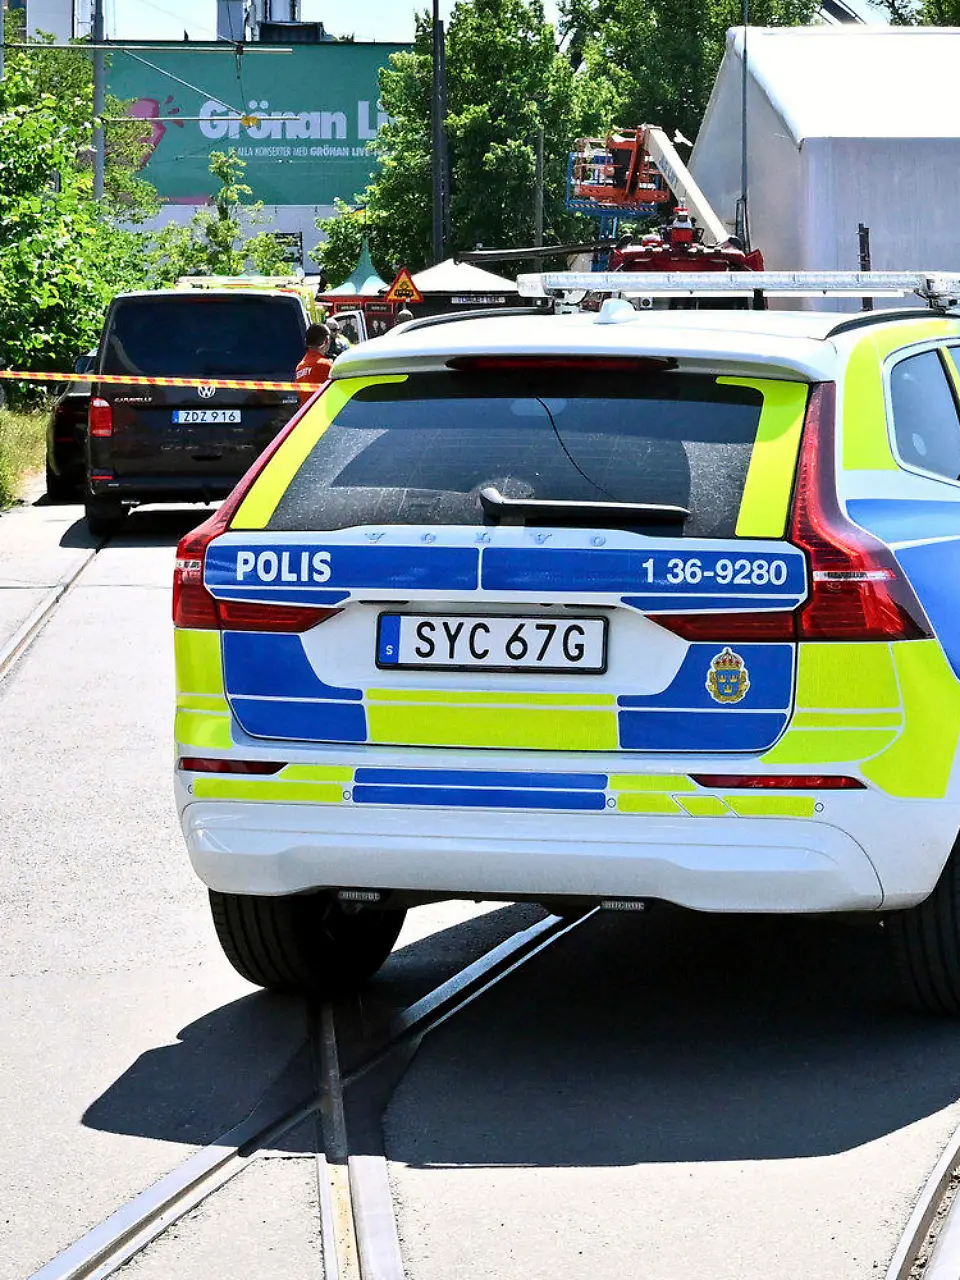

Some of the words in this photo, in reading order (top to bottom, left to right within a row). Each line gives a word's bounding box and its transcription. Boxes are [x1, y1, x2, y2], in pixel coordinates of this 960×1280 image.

[199, 99, 347, 139] Grönan
[310, 145, 349, 157] GRÖNAN
[183, 411, 207, 422] ZDZ
[212, 411, 236, 422] 916
[236, 551, 331, 583] POLIS
[642, 558, 654, 583] 1
[666, 559, 788, 586] 36-9280
[415, 621, 490, 660] SYC
[505, 623, 585, 663] 67G
